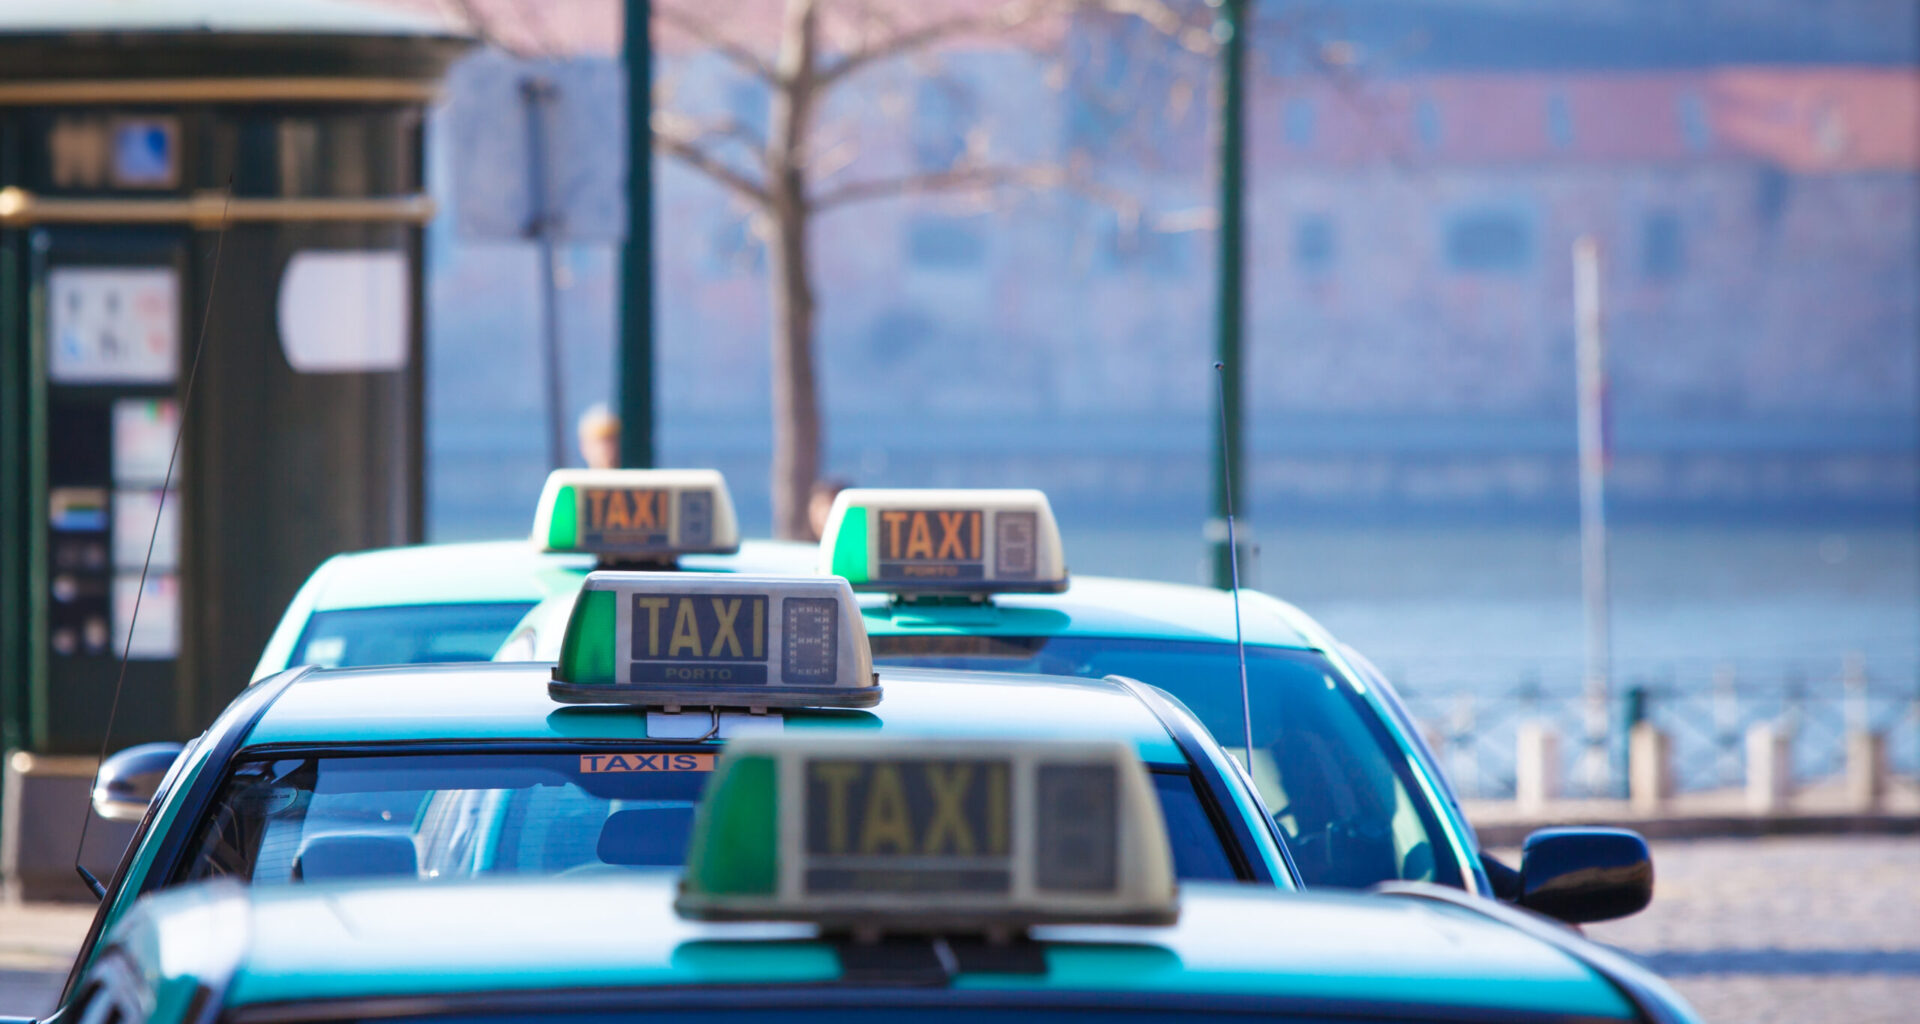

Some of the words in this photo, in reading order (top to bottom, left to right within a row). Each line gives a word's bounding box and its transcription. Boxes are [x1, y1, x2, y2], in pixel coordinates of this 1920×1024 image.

[587, 489, 669, 529] TAXI
[882, 511, 981, 559] TAXI
[638, 597, 765, 658] TAXI
[664, 667, 732, 680] PORTO
[582, 754, 698, 771] TAXIS
[815, 760, 1010, 853] TAXI
